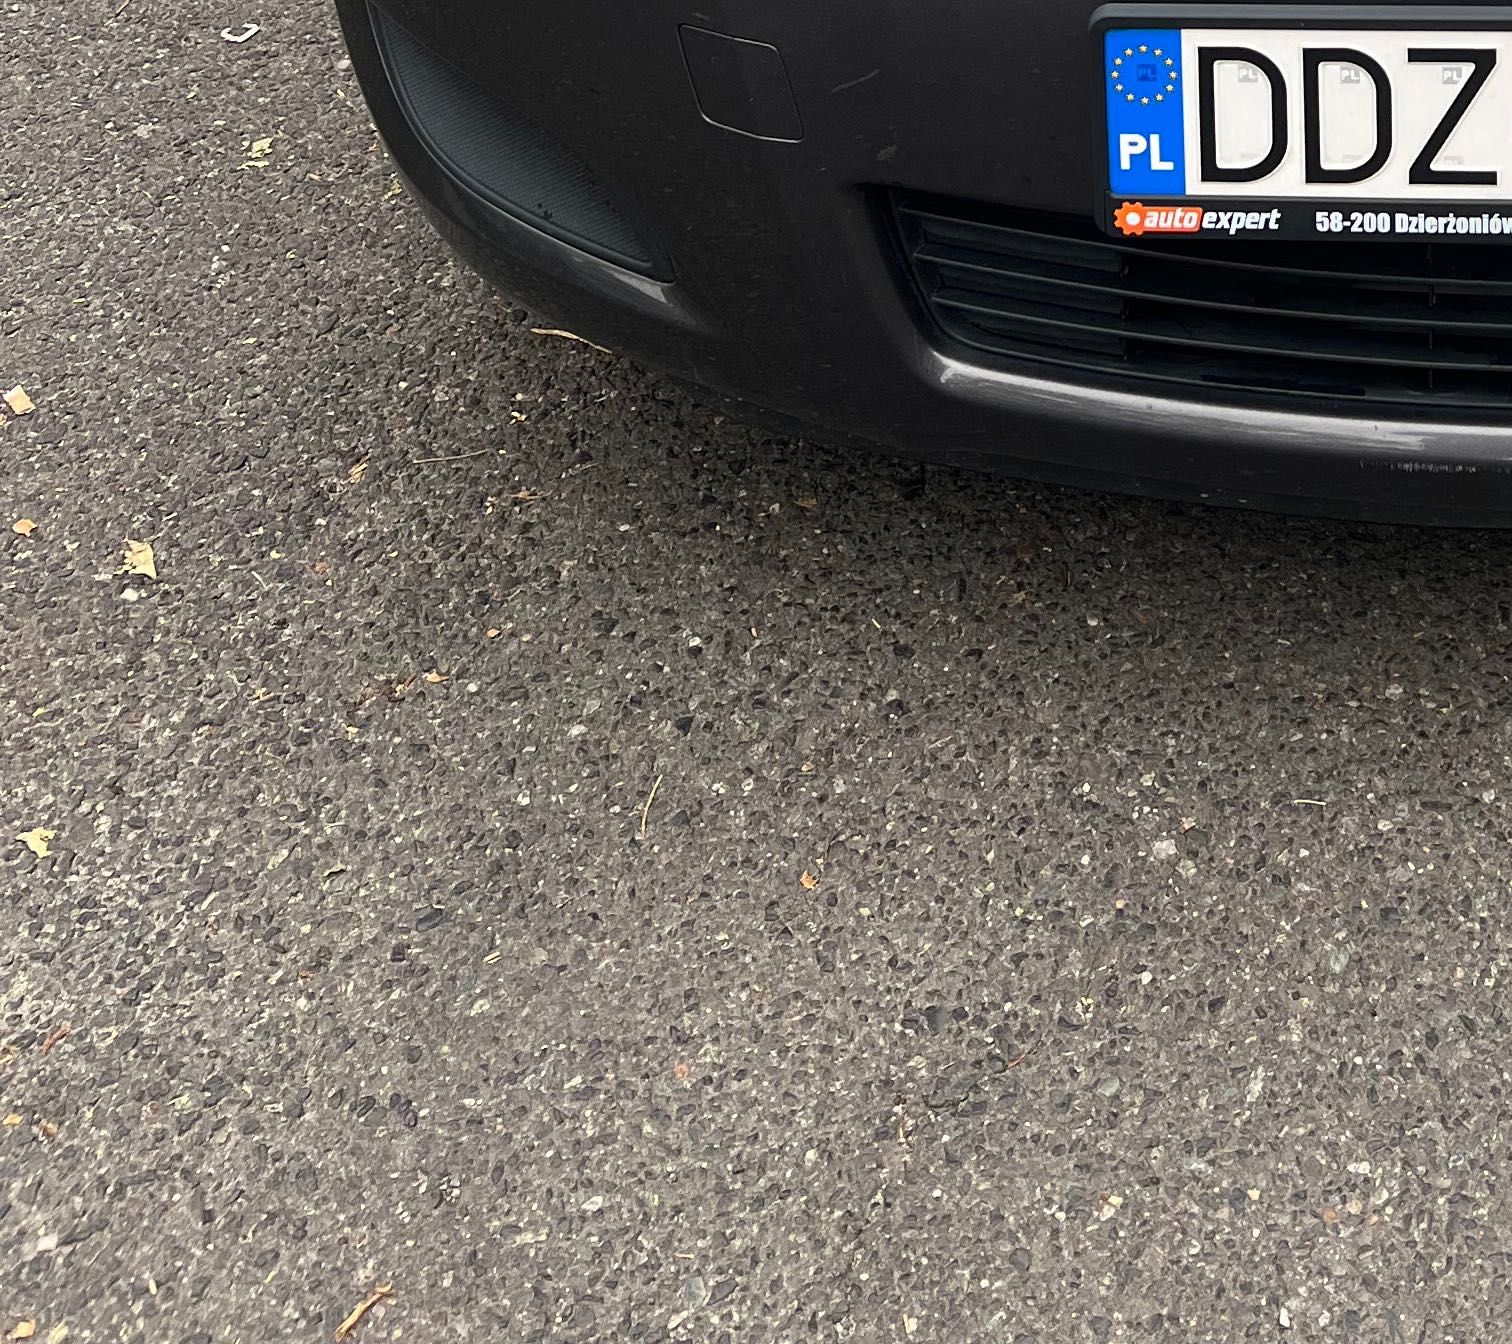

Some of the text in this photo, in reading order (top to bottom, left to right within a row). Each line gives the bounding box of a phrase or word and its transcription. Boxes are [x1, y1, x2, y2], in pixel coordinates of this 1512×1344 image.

[1197, 46, 1498, 185] DDZ
[1119, 133, 1175, 171] PL
[1315, 211, 1391, 233] 58-200
